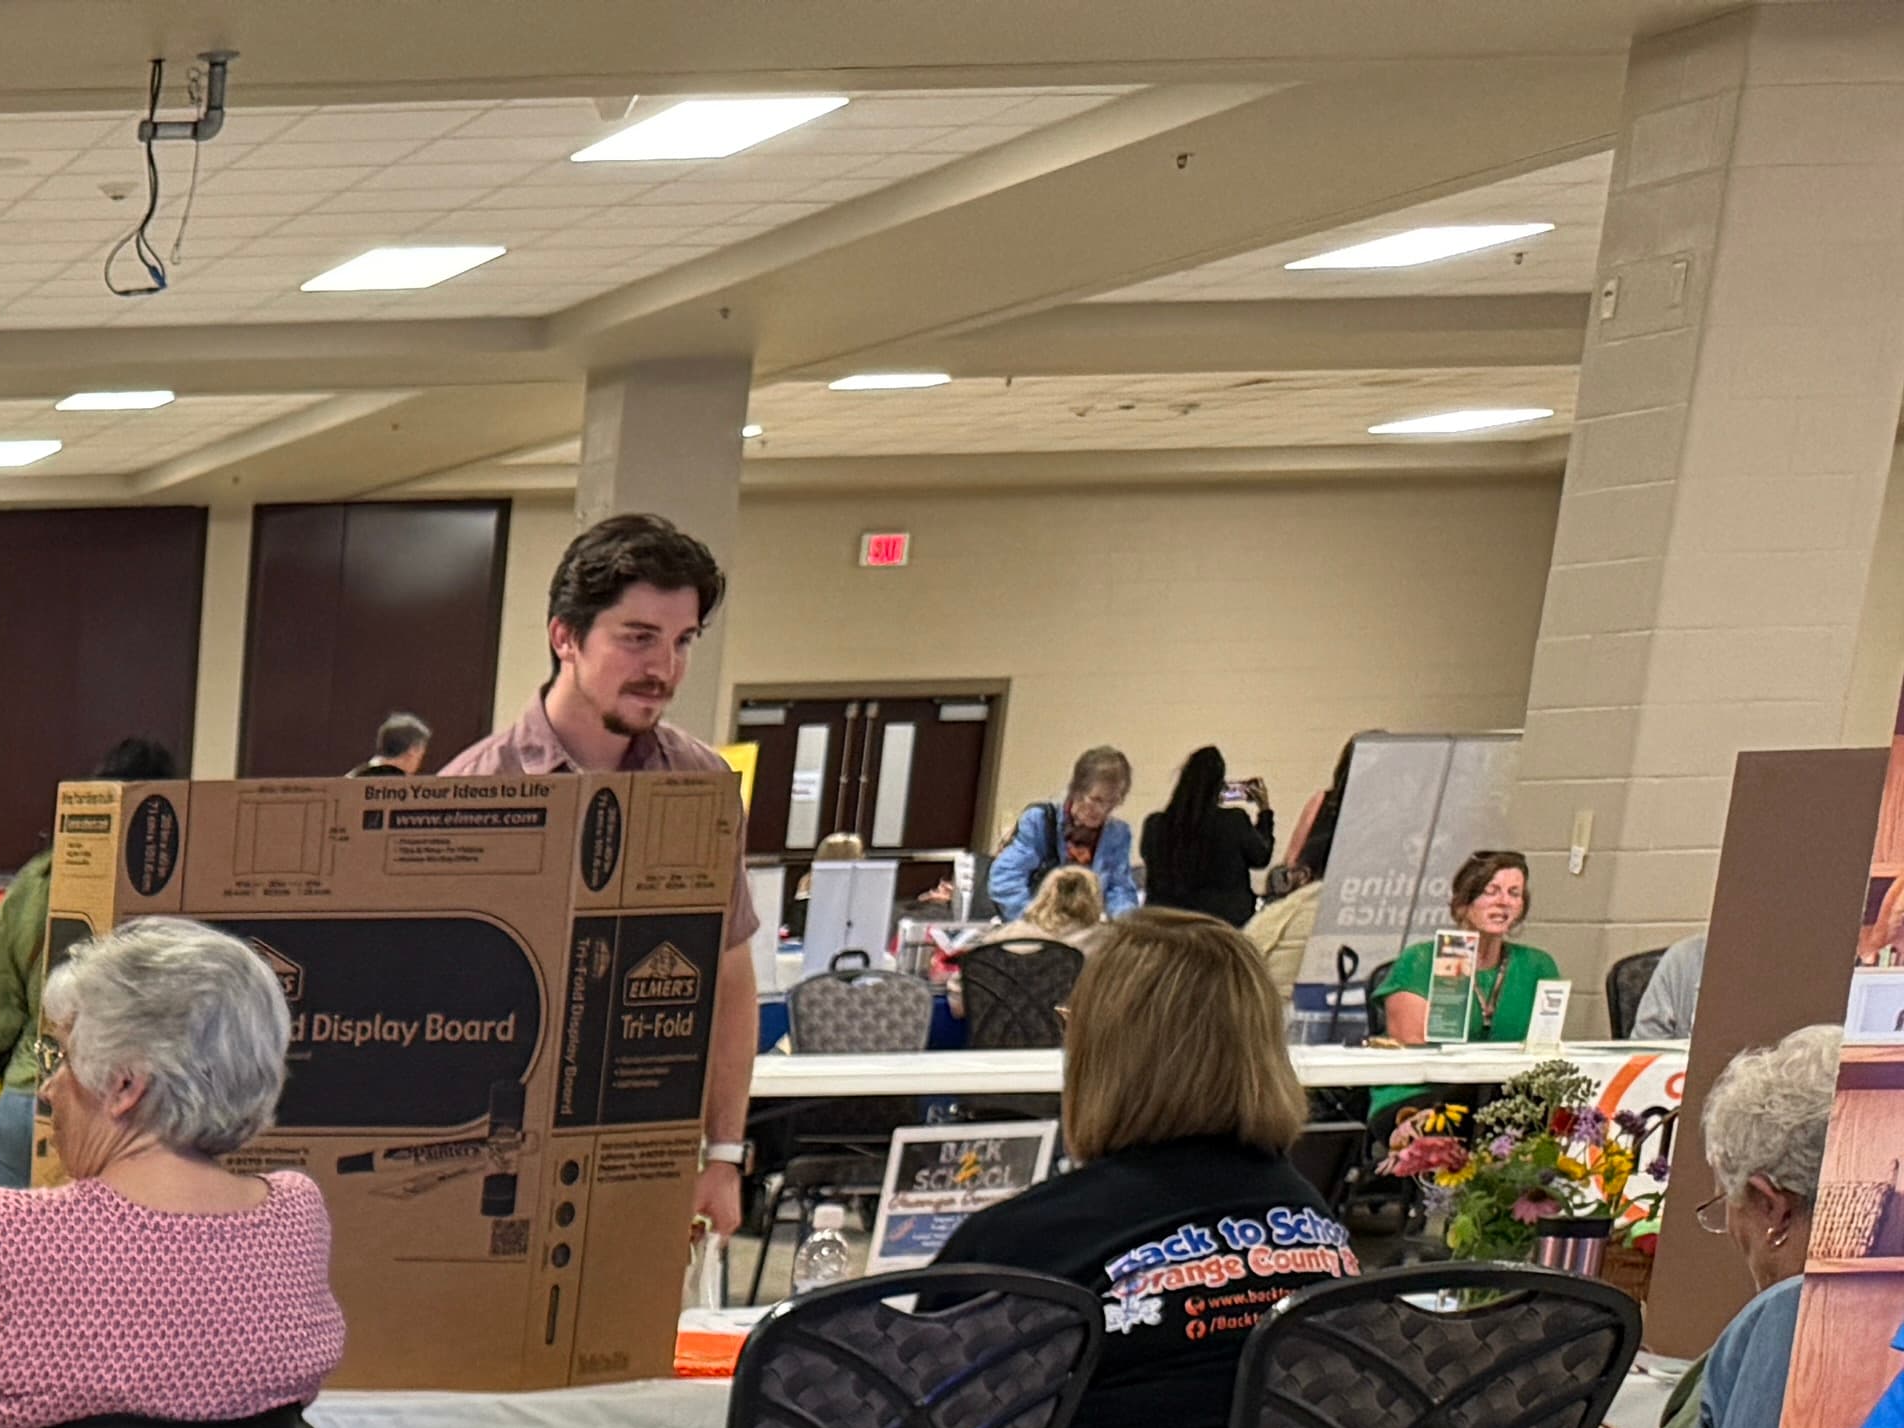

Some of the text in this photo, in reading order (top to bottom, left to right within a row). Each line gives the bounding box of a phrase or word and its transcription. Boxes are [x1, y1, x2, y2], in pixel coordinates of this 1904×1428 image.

[365, 784, 550, 801] Bring Your Ideas to Life
[395, 811, 539, 826] www.elmers.com
[628, 978, 696, 999] ELMER'S
[312, 1011, 517, 1047] Display Board
[621, 1011, 694, 1040] Tri-Fold
[1218, 1216, 1265, 1250] to
[1248, 1244, 1342, 1278] County
